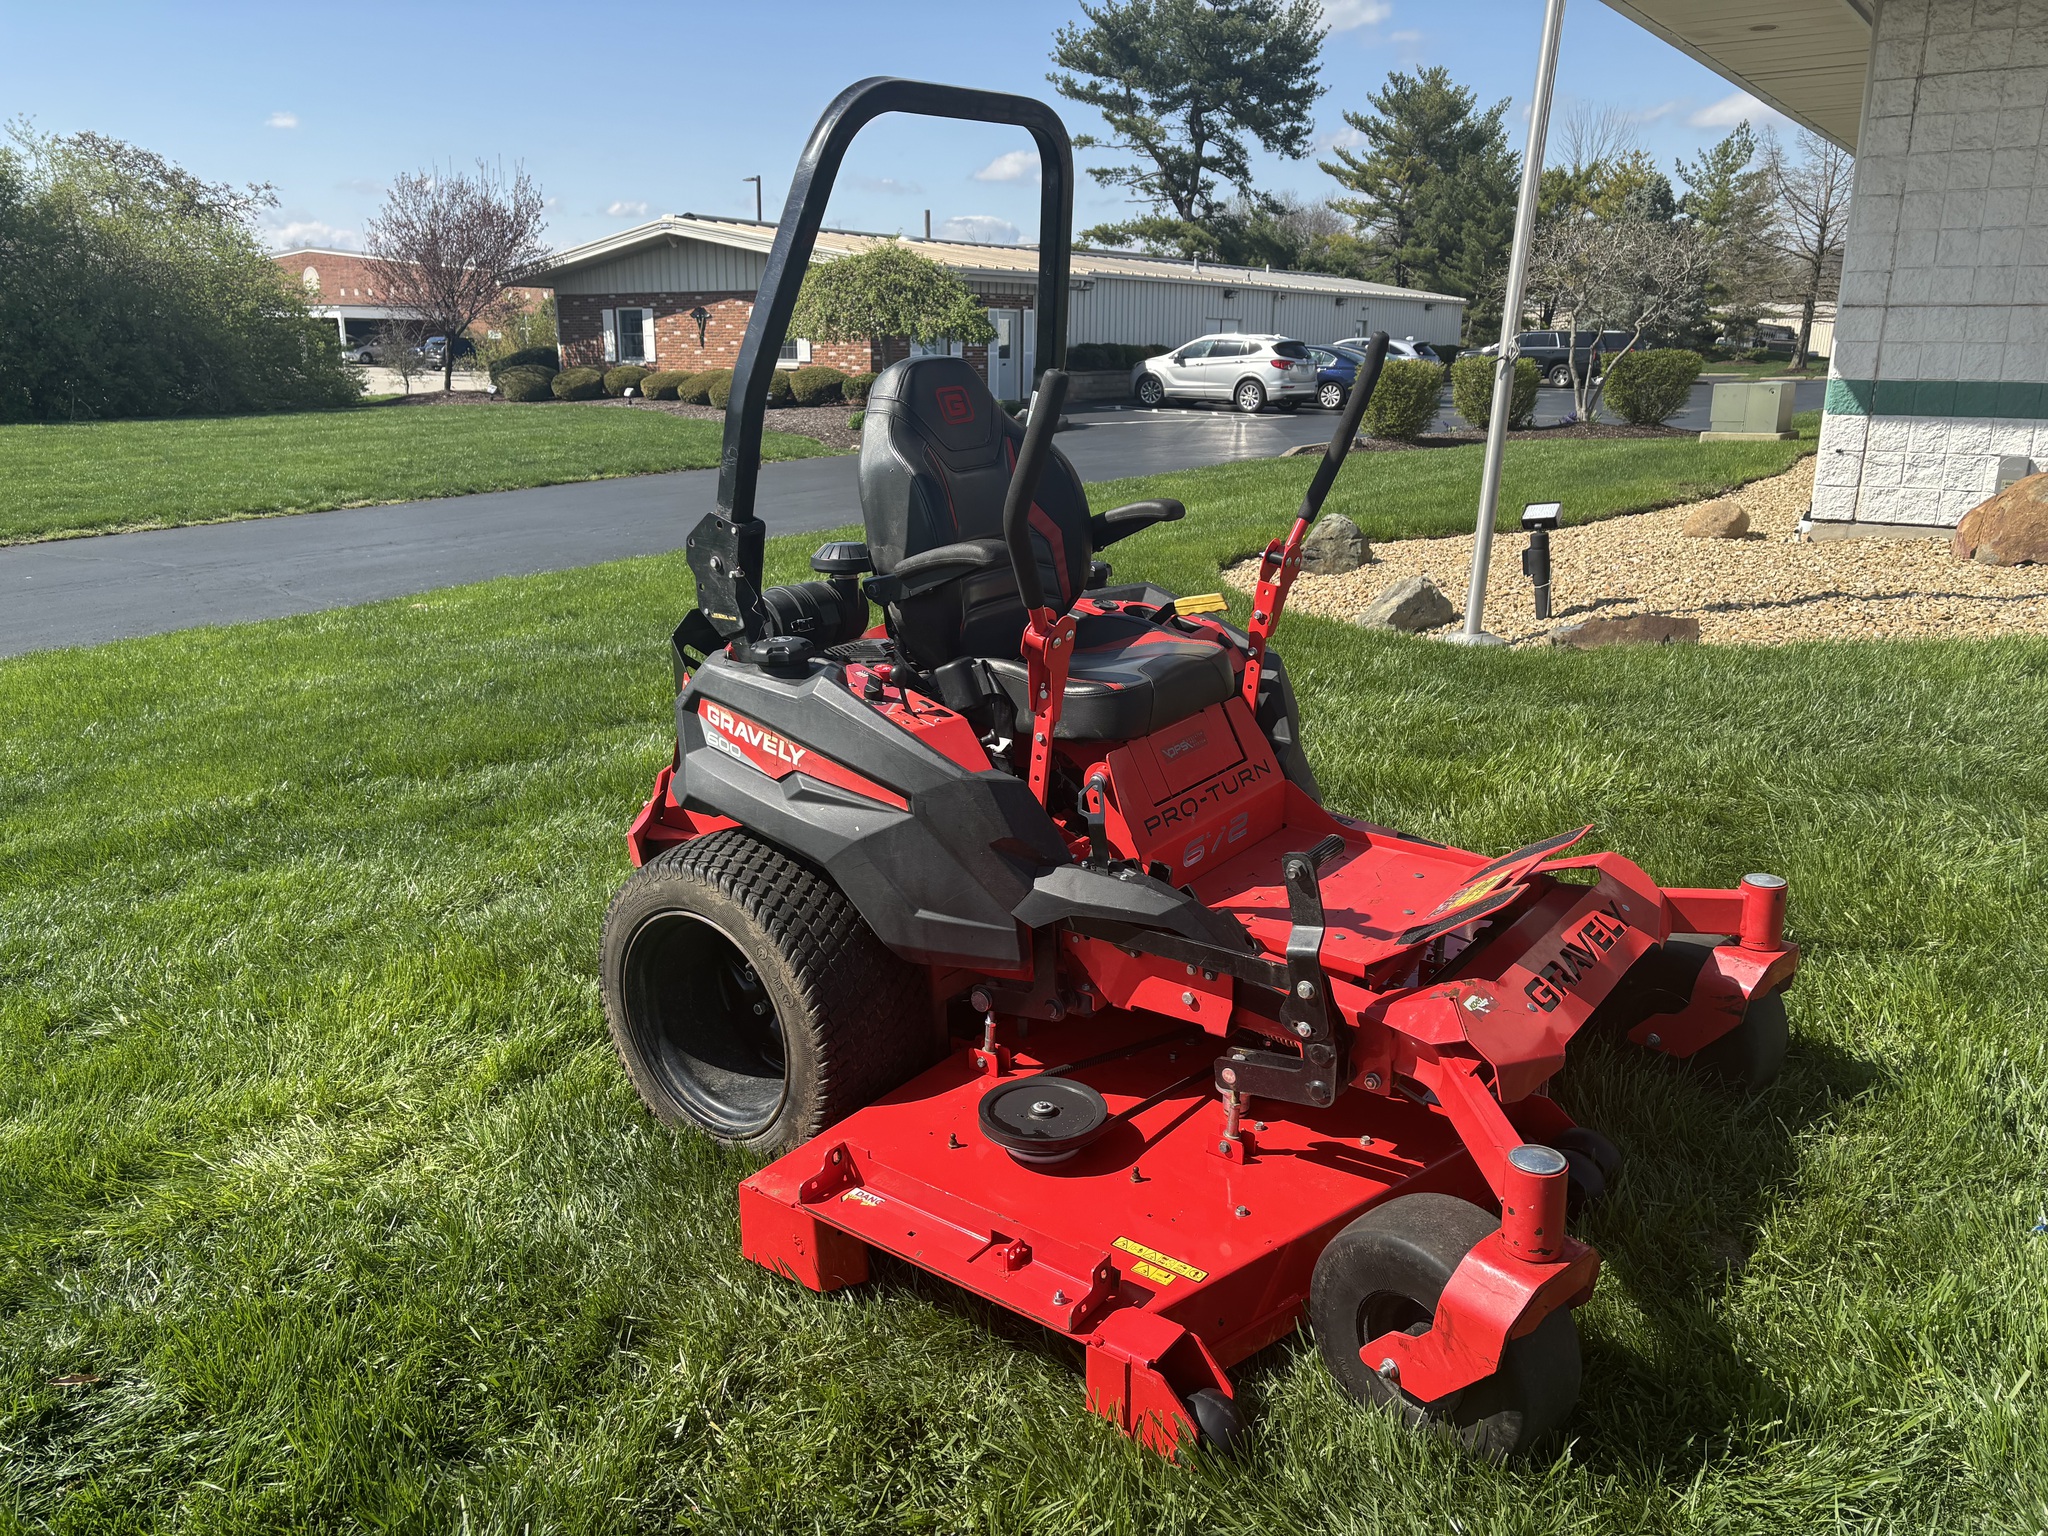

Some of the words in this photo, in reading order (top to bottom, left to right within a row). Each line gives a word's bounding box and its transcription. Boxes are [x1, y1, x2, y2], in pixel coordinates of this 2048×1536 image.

[706, 704, 806, 766] GRAVELY
[706, 731, 742, 758] 600
[1143, 758, 1271, 837] PRO-TURN
[1523, 899, 1632, 1013] GRAVELY
